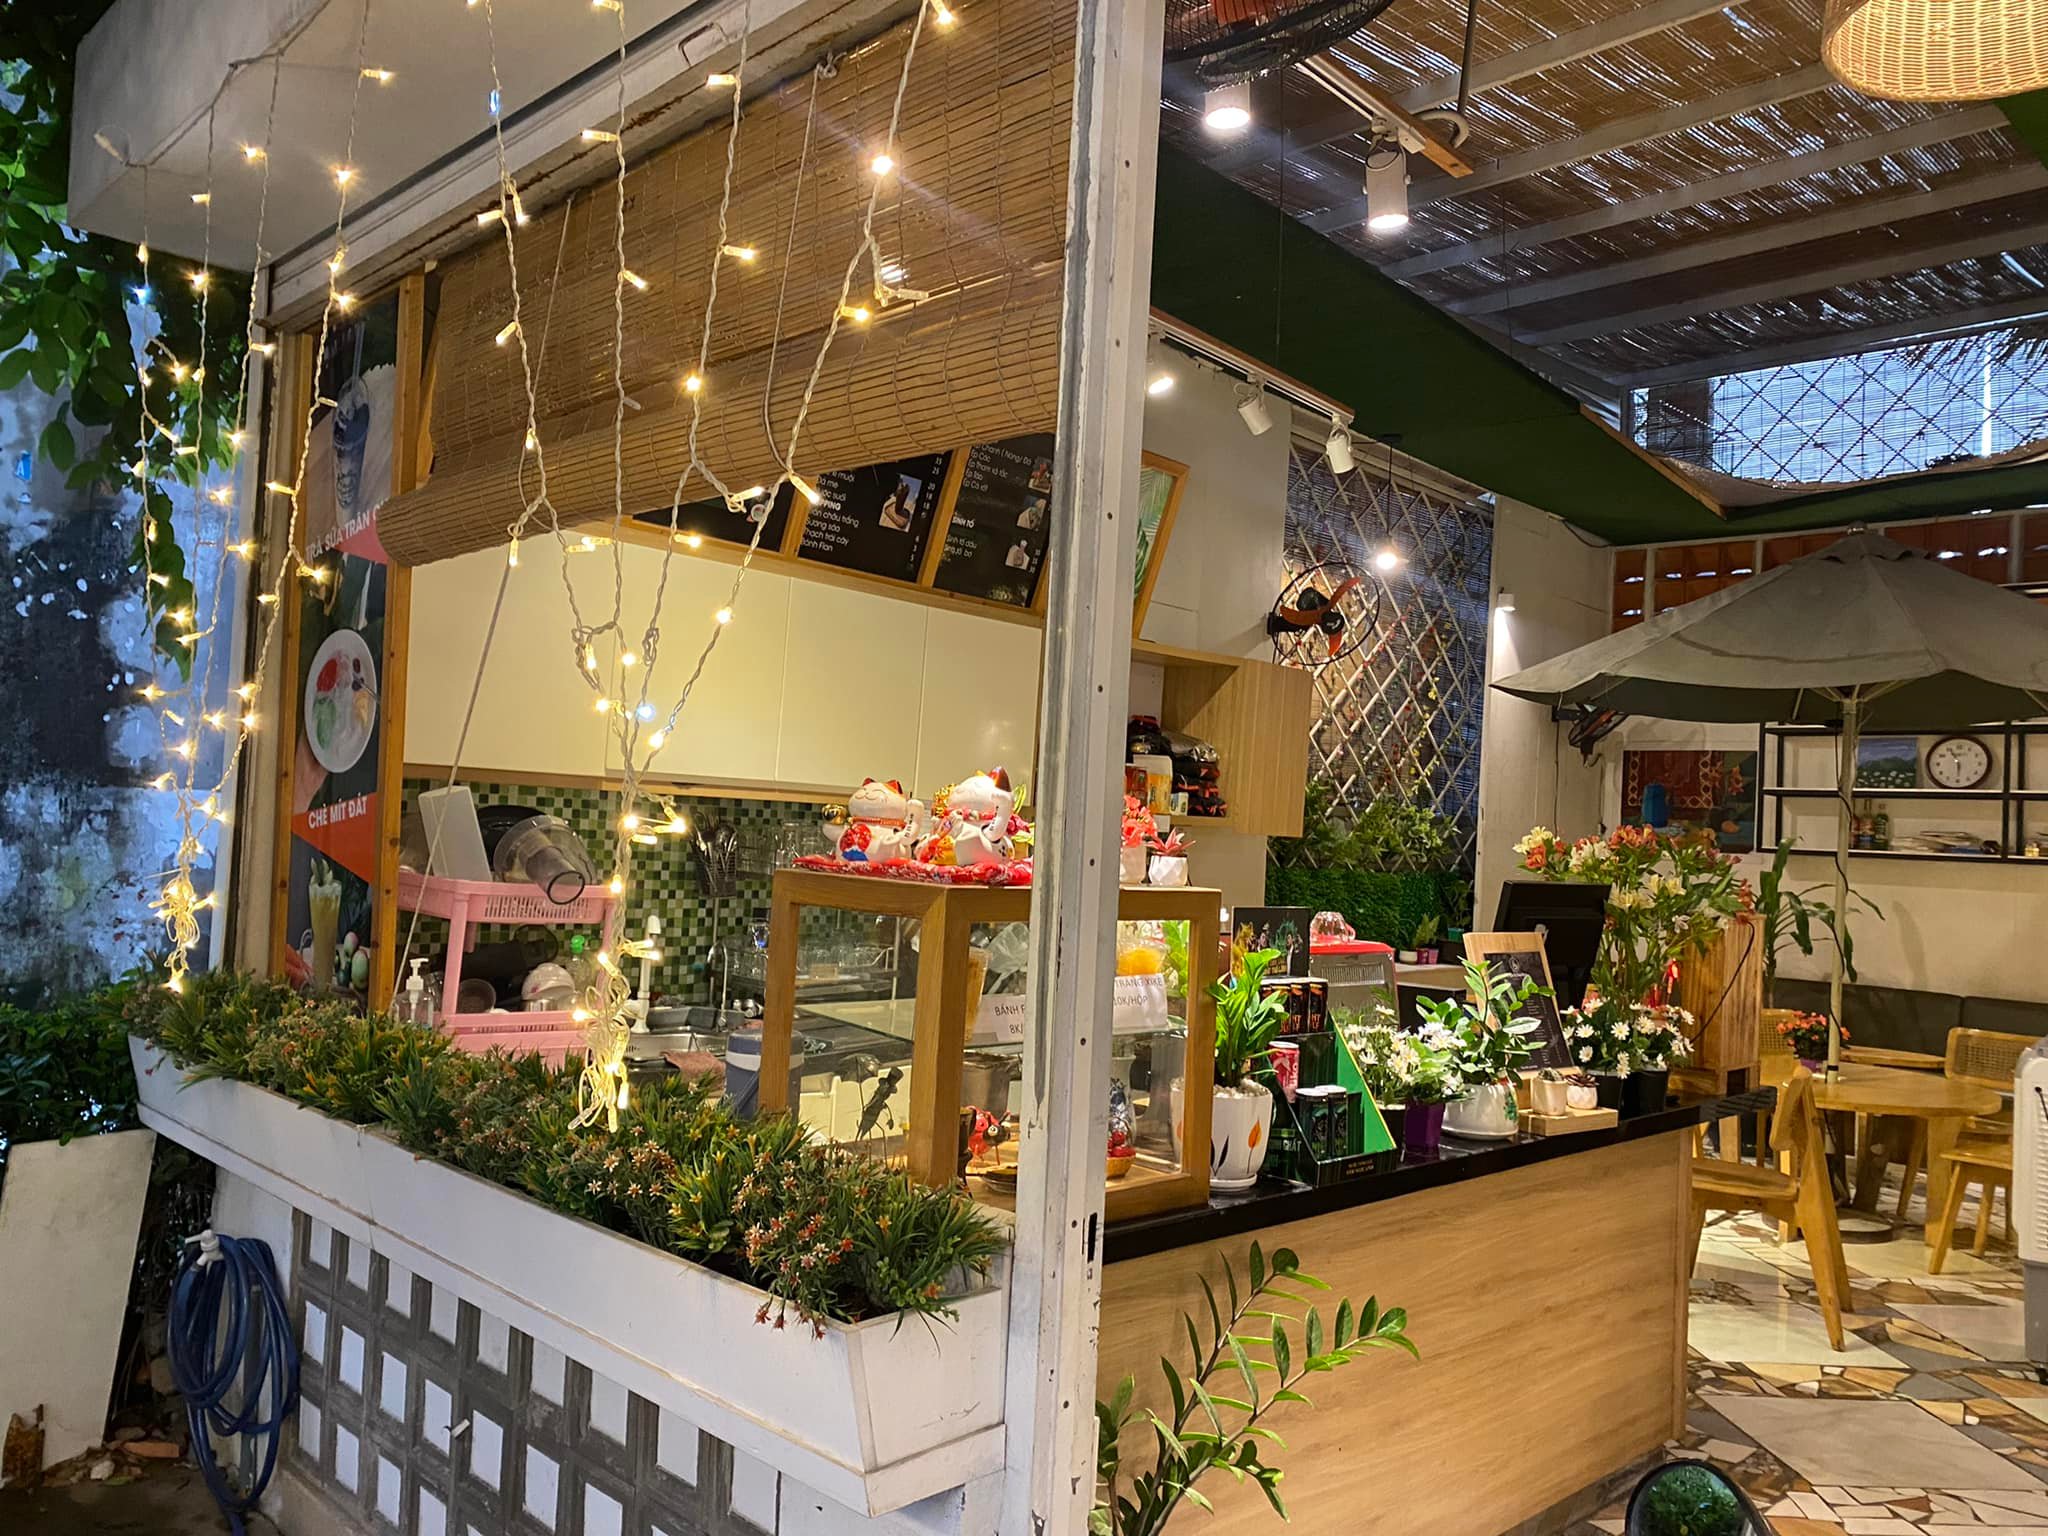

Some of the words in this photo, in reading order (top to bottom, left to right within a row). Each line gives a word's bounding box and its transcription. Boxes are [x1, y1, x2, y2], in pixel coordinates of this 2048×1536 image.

[308, 803, 328, 829] CHÈ
[329, 797, 347, 824] MÍT
[994, 1002, 1019, 1016] BÁNH
